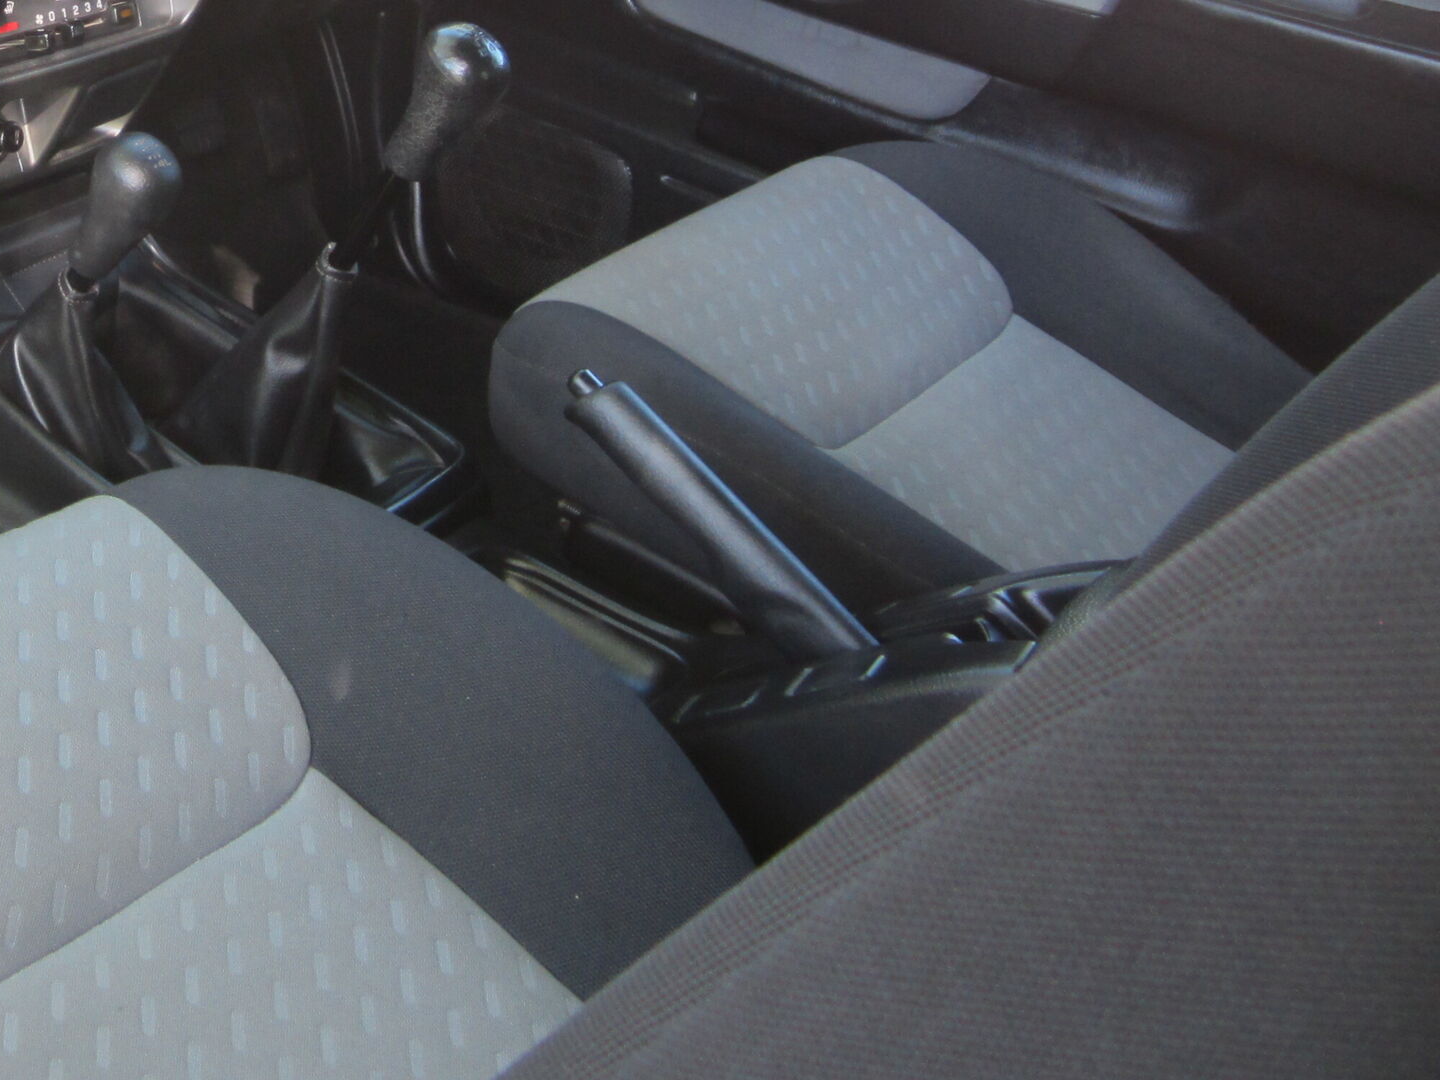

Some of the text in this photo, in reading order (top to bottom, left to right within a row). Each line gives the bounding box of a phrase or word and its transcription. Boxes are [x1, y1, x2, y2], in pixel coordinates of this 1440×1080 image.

[48, 0, 103, 22] 0 1 2 3 4
